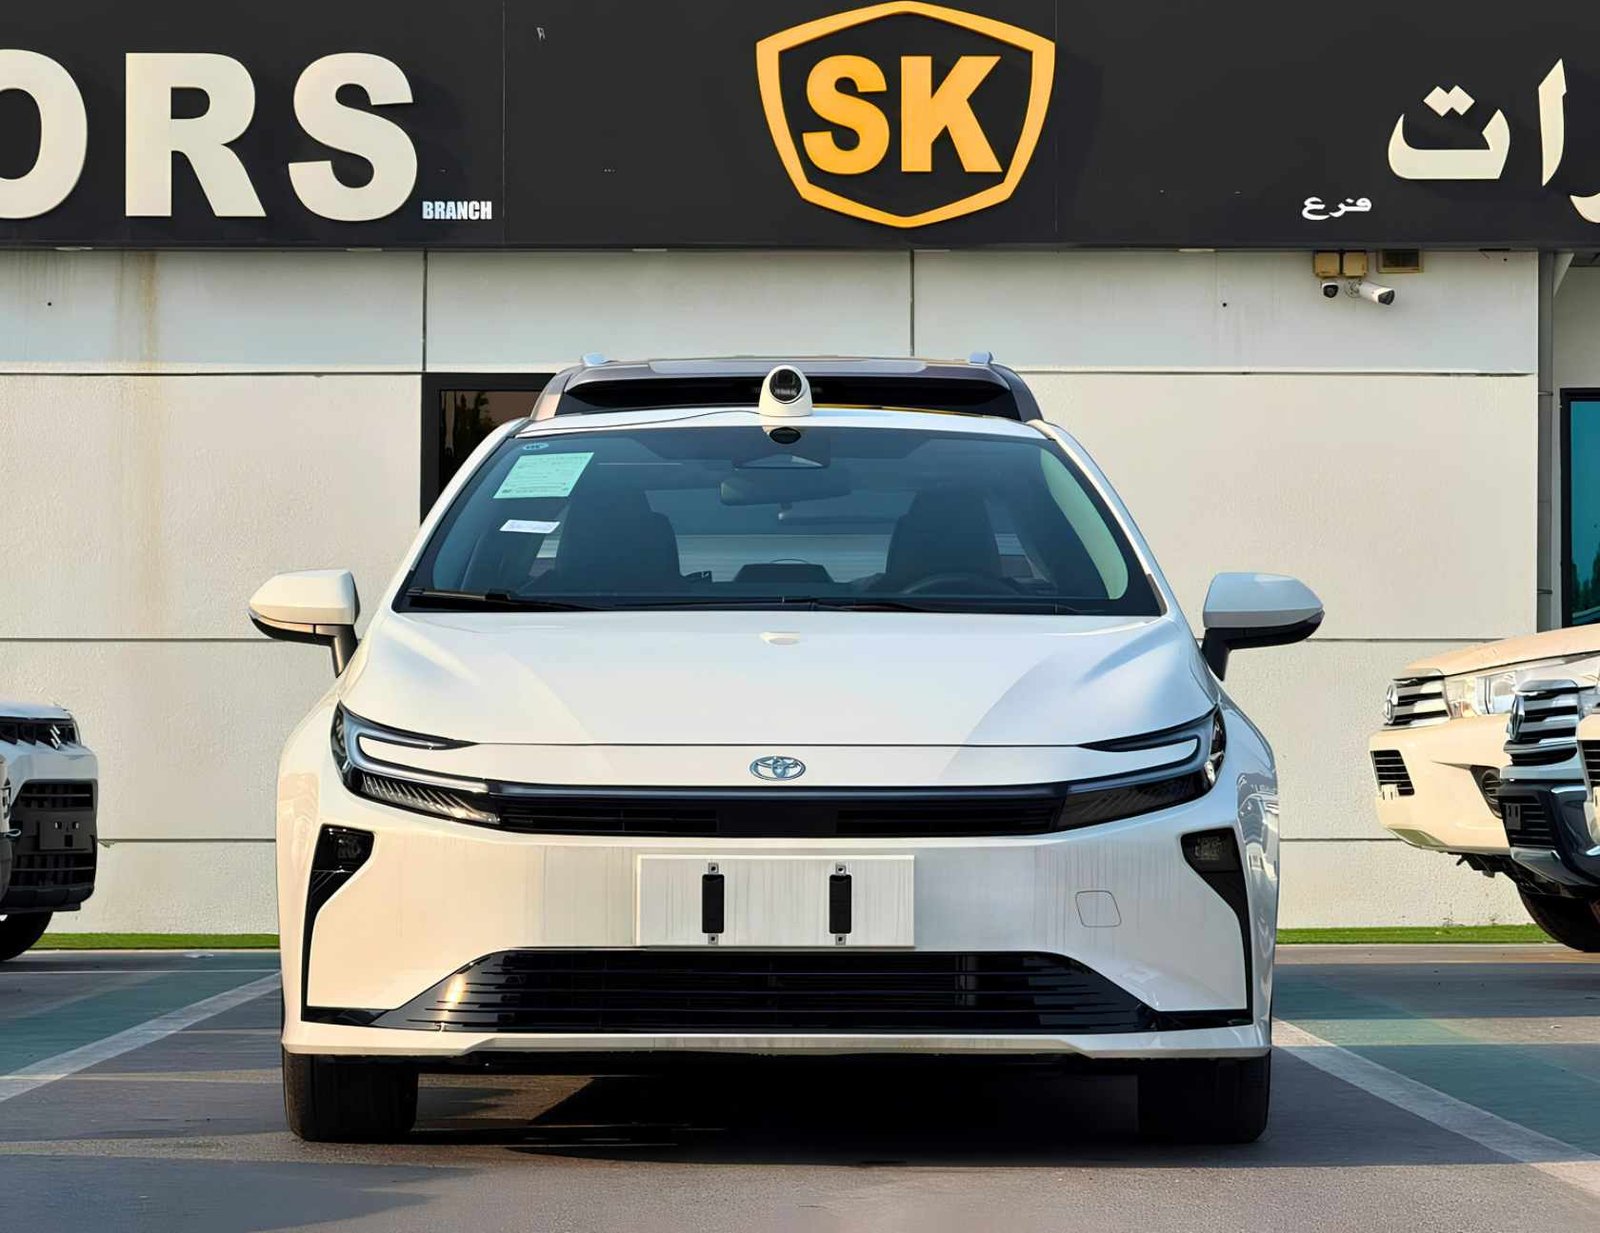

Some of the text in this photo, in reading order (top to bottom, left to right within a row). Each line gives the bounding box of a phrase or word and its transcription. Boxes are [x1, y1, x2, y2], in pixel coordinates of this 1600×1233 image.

[802, 54, 1003, 175] SK
[422, 200, 493, 221] BRANCH
[1301, 196, 1372, 221] فرع
